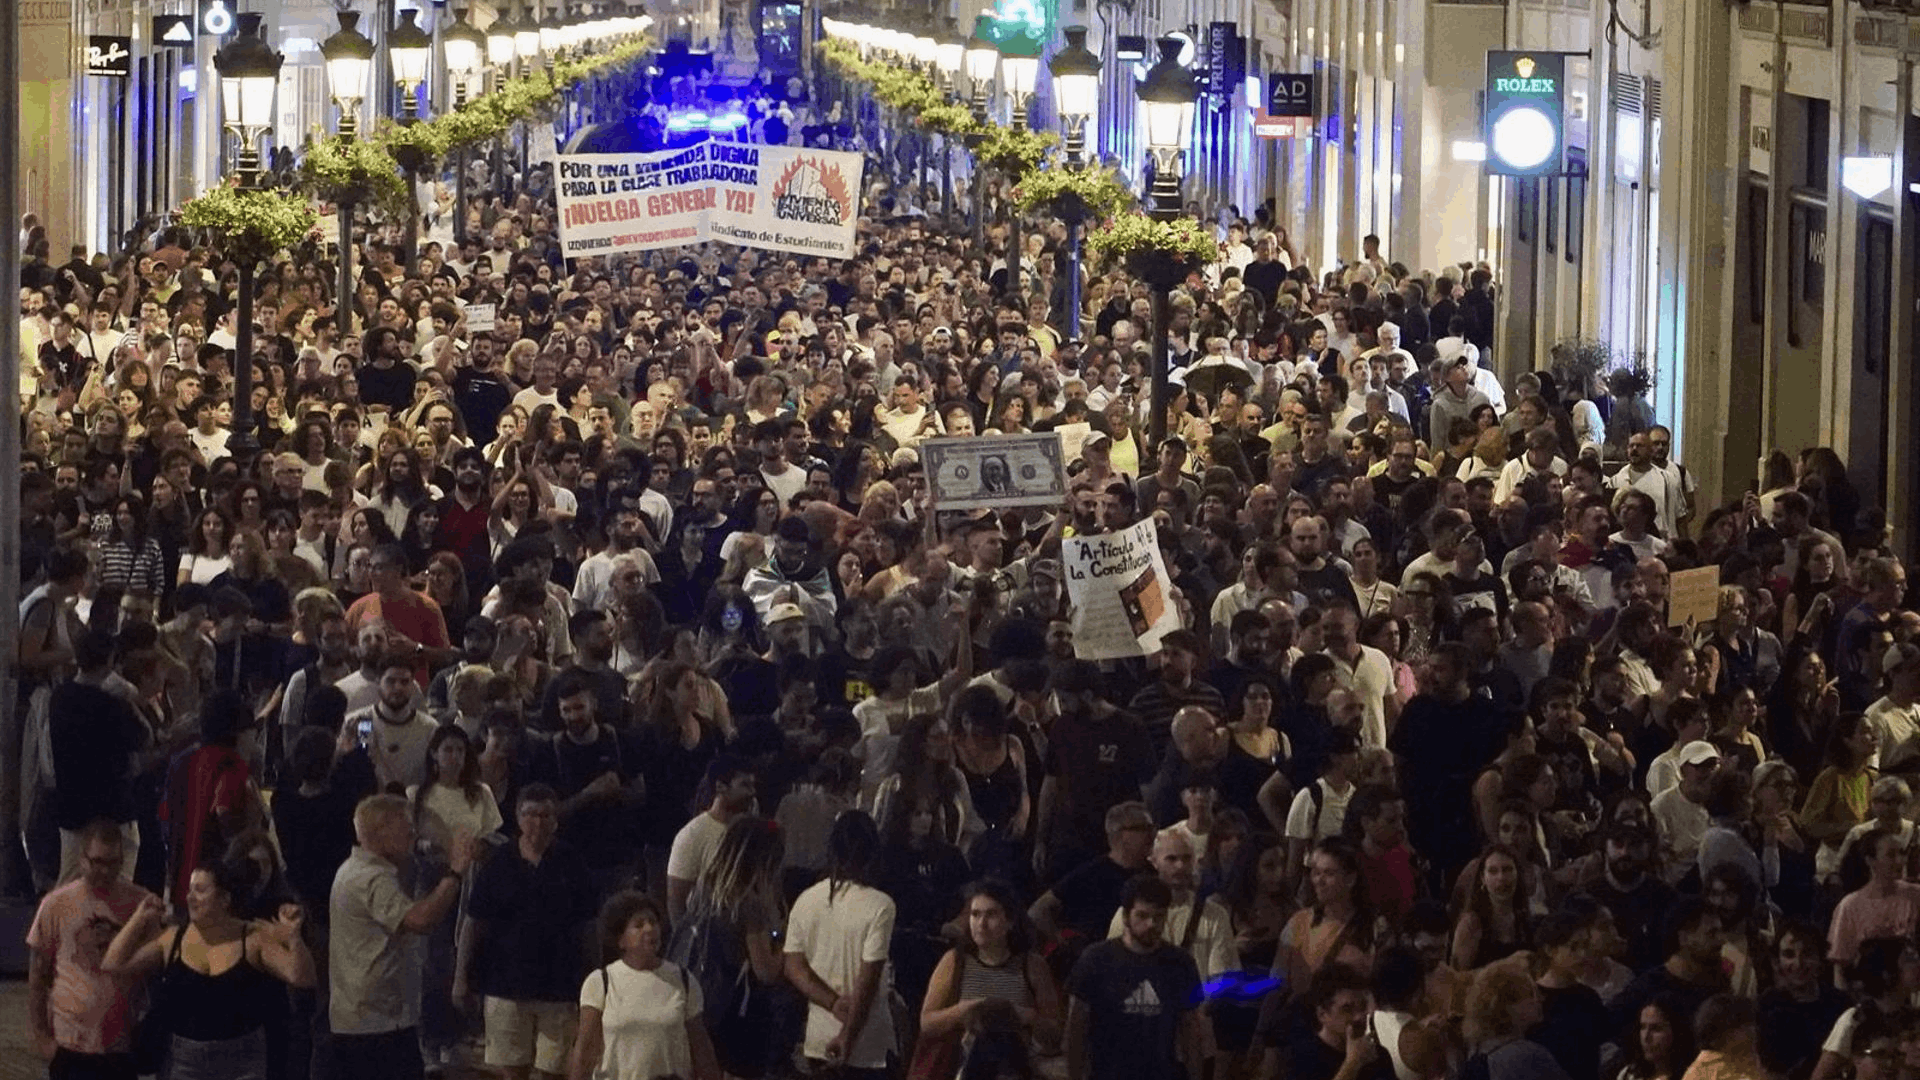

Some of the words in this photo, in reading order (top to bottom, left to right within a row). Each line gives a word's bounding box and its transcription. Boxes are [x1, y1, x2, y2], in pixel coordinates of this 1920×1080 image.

[1211, 27, 1224, 91] PRIMOR
[1497, 78, 1554, 92] ROLEX
[560, 162, 592, 178] POR
[597, 163, 629, 178] UNA
[710, 143, 758, 166] DIGNA
[562, 181, 597, 197] PARA
[601, 180, 617, 194] LA
[564, 198, 641, 229] ¡HUELGA
[725, 189, 755, 214] YA!
[778, 210, 843, 227] UNIVERSAL
[759, 230, 773, 242] de
[775, 232, 844, 251] Estudiantes
